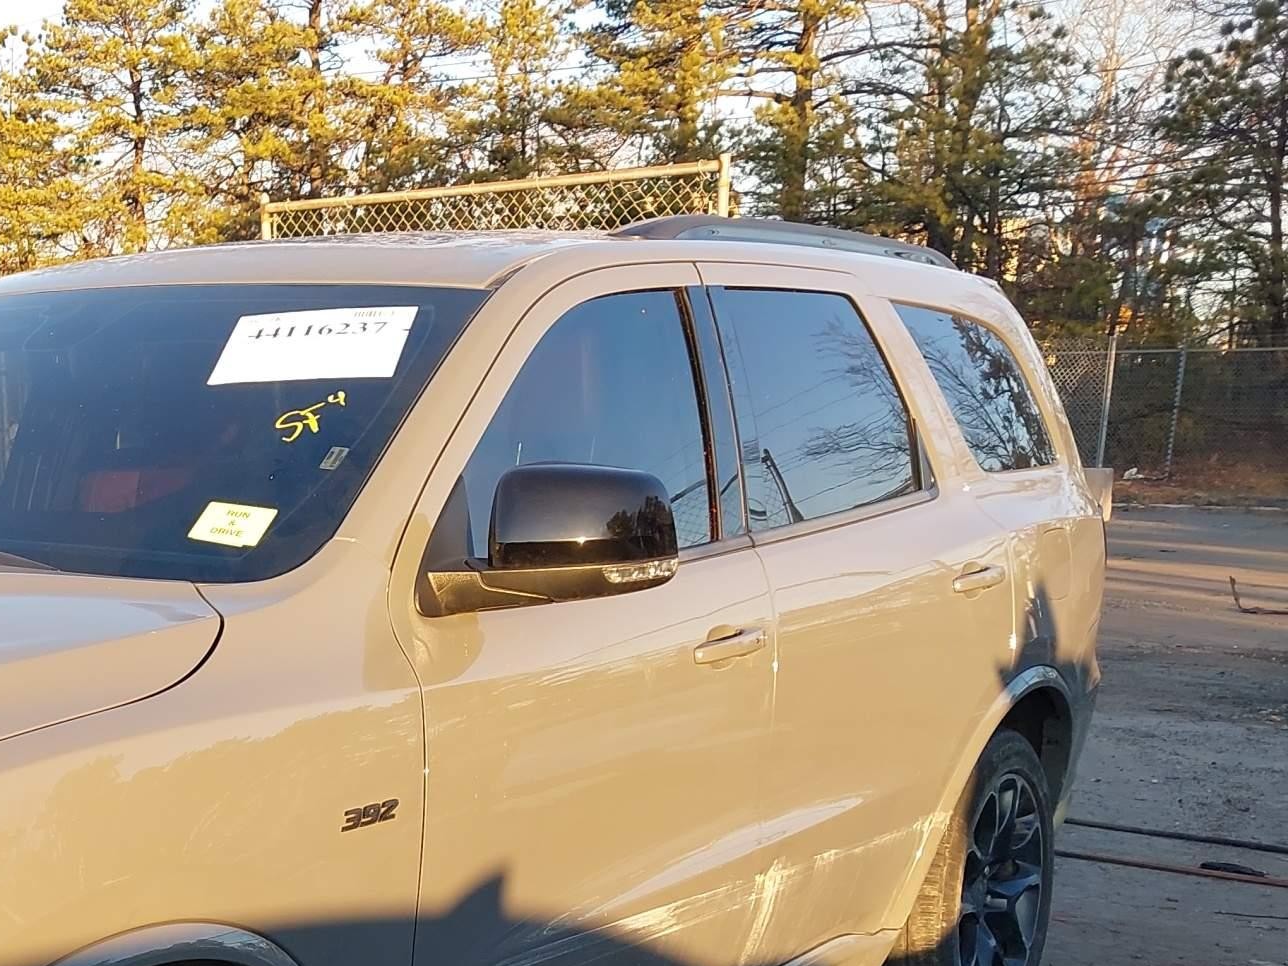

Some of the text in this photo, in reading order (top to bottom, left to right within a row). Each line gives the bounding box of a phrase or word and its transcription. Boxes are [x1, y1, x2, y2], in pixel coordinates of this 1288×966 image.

[248, 320, 388, 340] 44116237
[225, 509, 250, 520] RUN
[209, 527, 243, 538] DRIVE
[340, 798, 400, 832] 392
